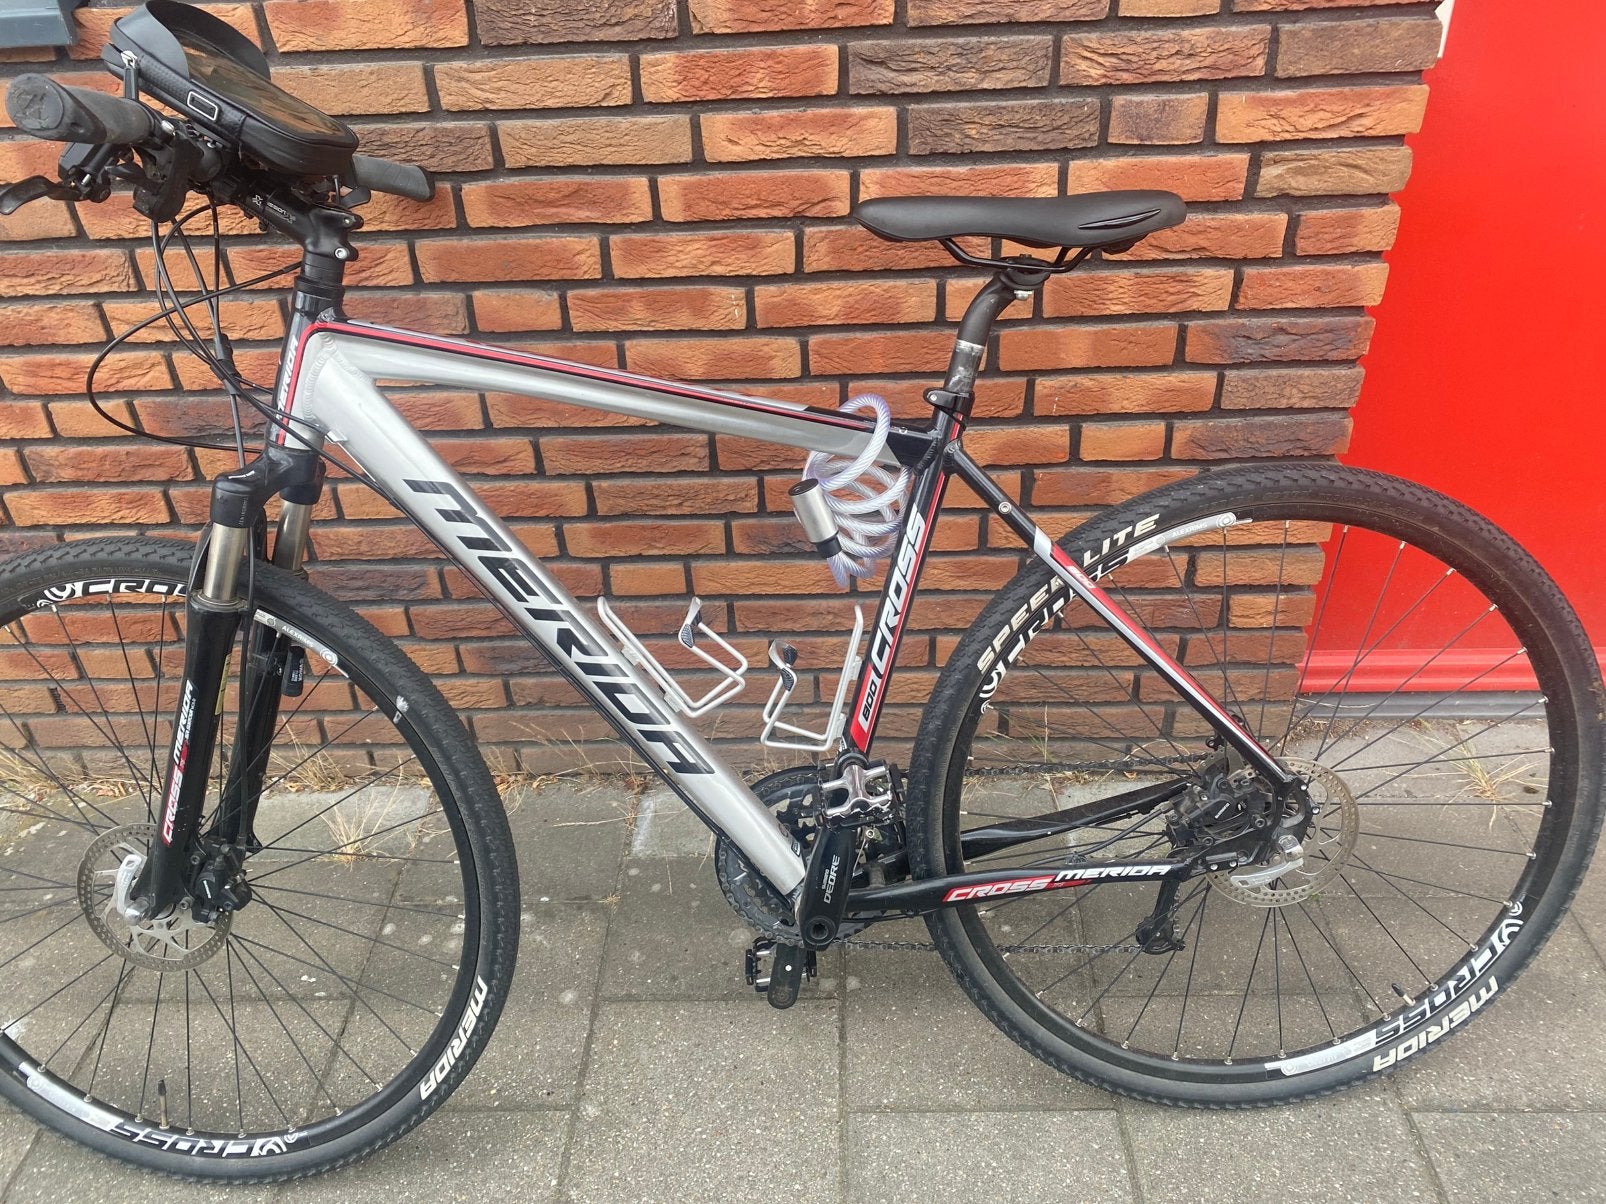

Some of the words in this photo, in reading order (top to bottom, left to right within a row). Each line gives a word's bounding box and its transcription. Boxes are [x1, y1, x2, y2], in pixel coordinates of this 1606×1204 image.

[1084, 514, 1159, 568] LITE
[402, 479, 715, 774] MERIDA
[871, 503, 925, 677] CROSS
[173, 680, 193, 765] MERIDA
[862, 679, 878, 722] 800
[164, 765, 183, 843] CROSS
[824, 854, 840, 904] DEORE
[947, 878, 1054, 902] CROSS
[1054, 865, 1172, 882] MERIDA
[420, 974, 488, 1100] MERIDA
[1373, 975, 1498, 1072] MERIDA
